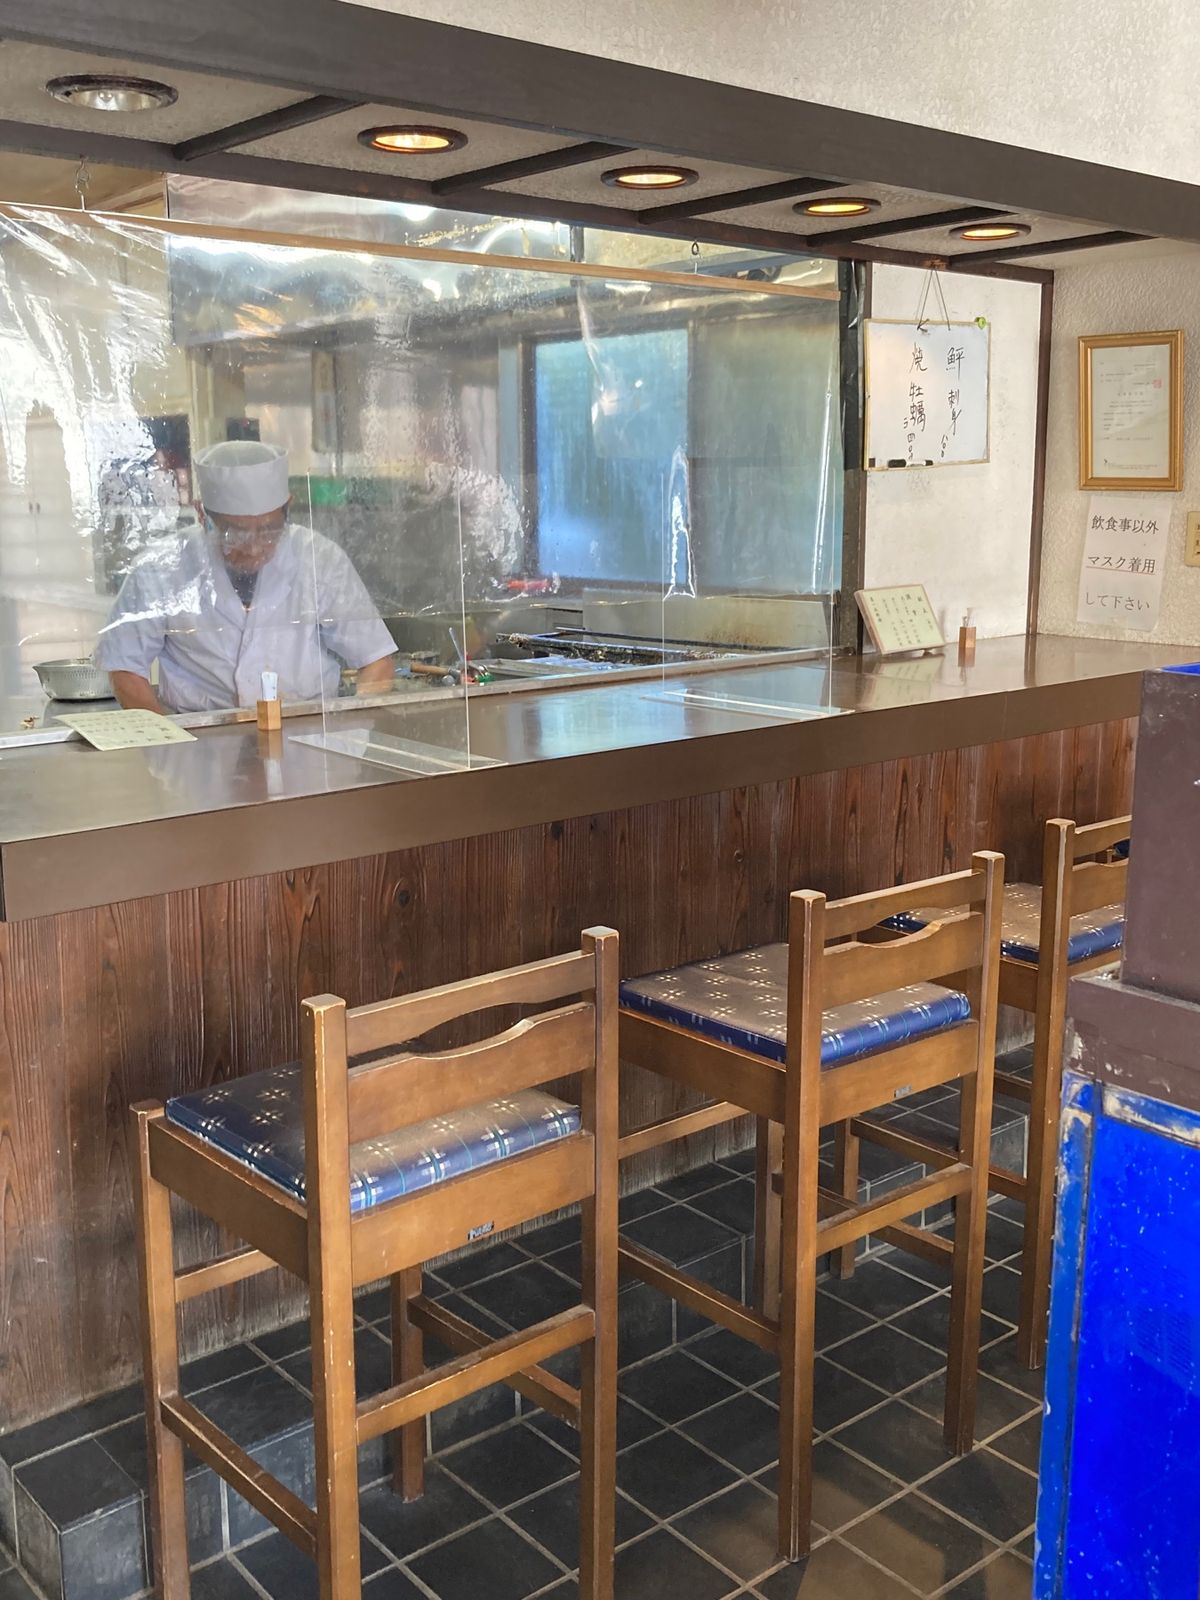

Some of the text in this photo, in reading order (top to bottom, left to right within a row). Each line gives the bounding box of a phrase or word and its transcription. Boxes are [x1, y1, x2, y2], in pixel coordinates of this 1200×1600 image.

[1091, 514, 1159, 535] 飲食事以外
[1087, 555, 1156, 574] マスク着用
[1085, 592, 1150, 611] して下さい
